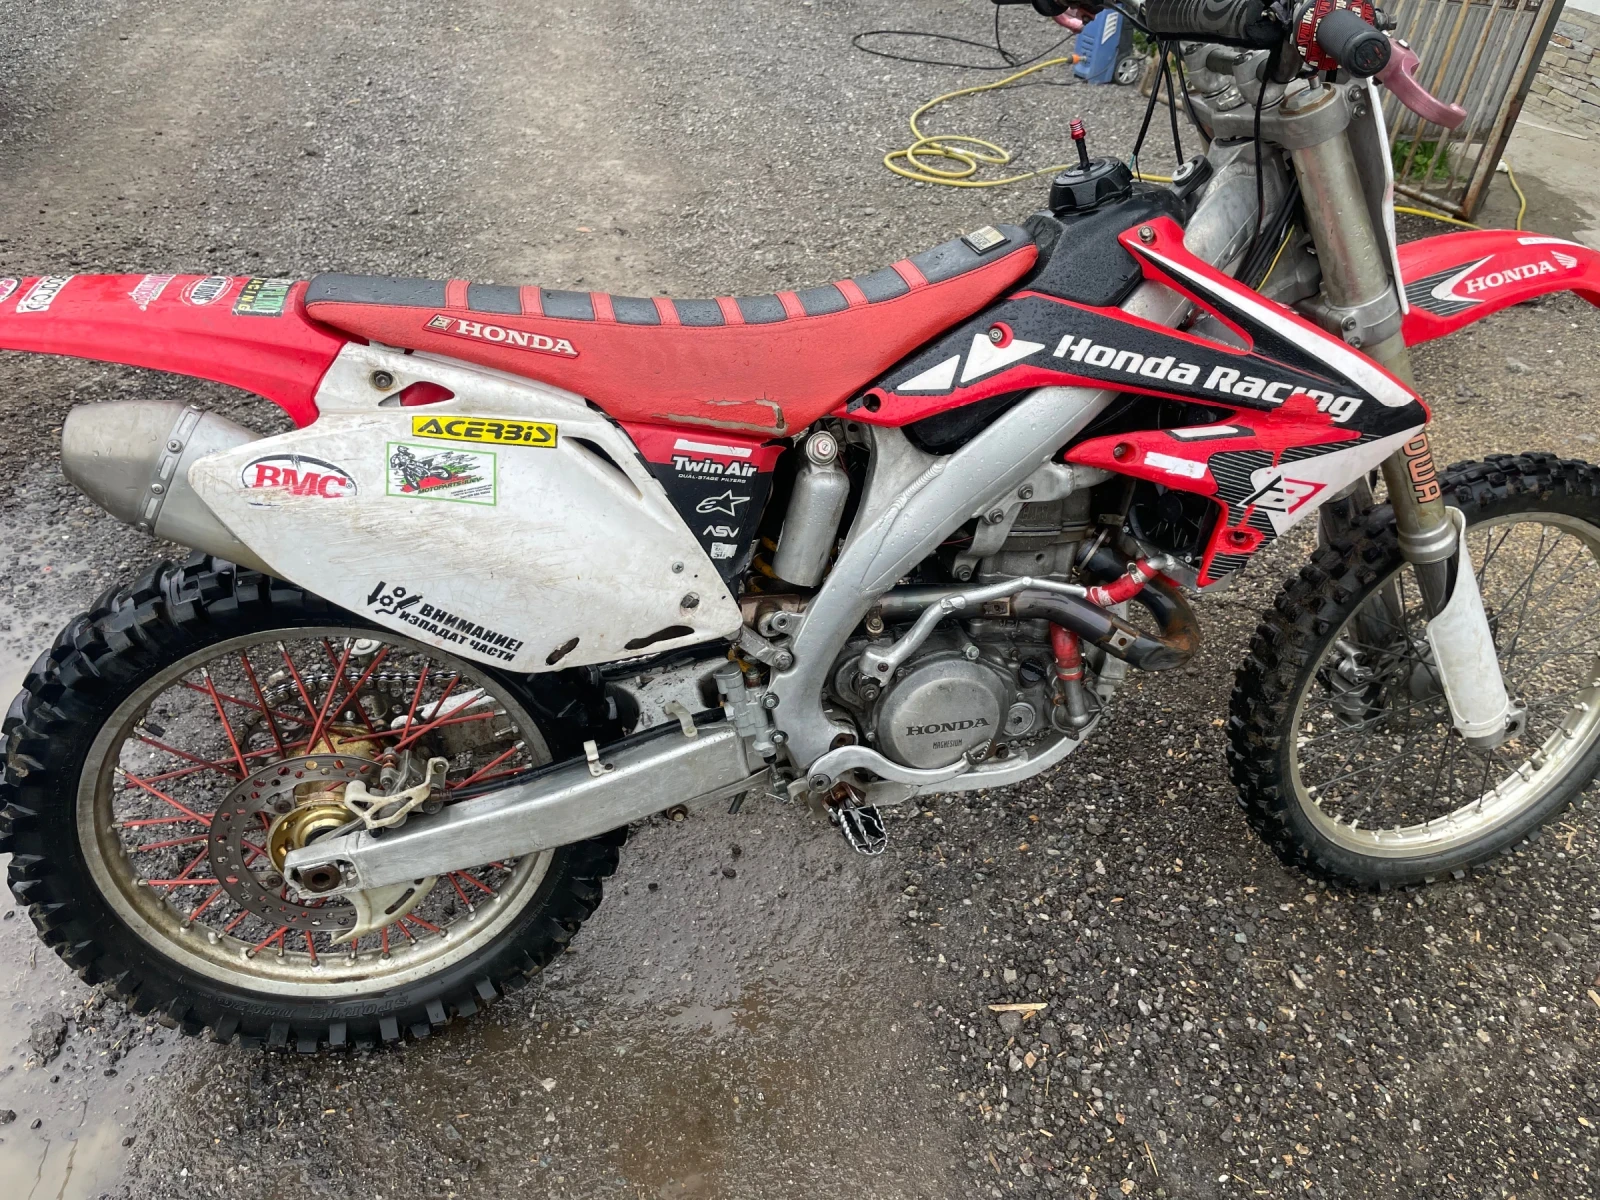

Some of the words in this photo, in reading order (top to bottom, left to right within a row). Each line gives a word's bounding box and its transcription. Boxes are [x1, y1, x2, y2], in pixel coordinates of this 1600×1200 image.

[1464, 260, 1557, 294] HONDA
[455, 319, 578, 355] HONDA
[1053, 334, 1200, 385] Honda
[252, 464, 347, 499] BMC
[672, 455, 723, 475] Twin
[724, 460, 758, 477] Air
[678, 473, 720, 482] DUAL-STAGE
[1402, 432, 1442, 504] OWA
[702, 524, 740, 538] ASV
[398, 610, 469, 646] ИЗПАДАТ
[469, 639, 516, 663] ЧАСТИ
[418, 602, 525, 654] ВНИМАНИЕ!
[905, 717, 991, 737] HONDA
[932, 738, 963, 750] MAGNESIUM
